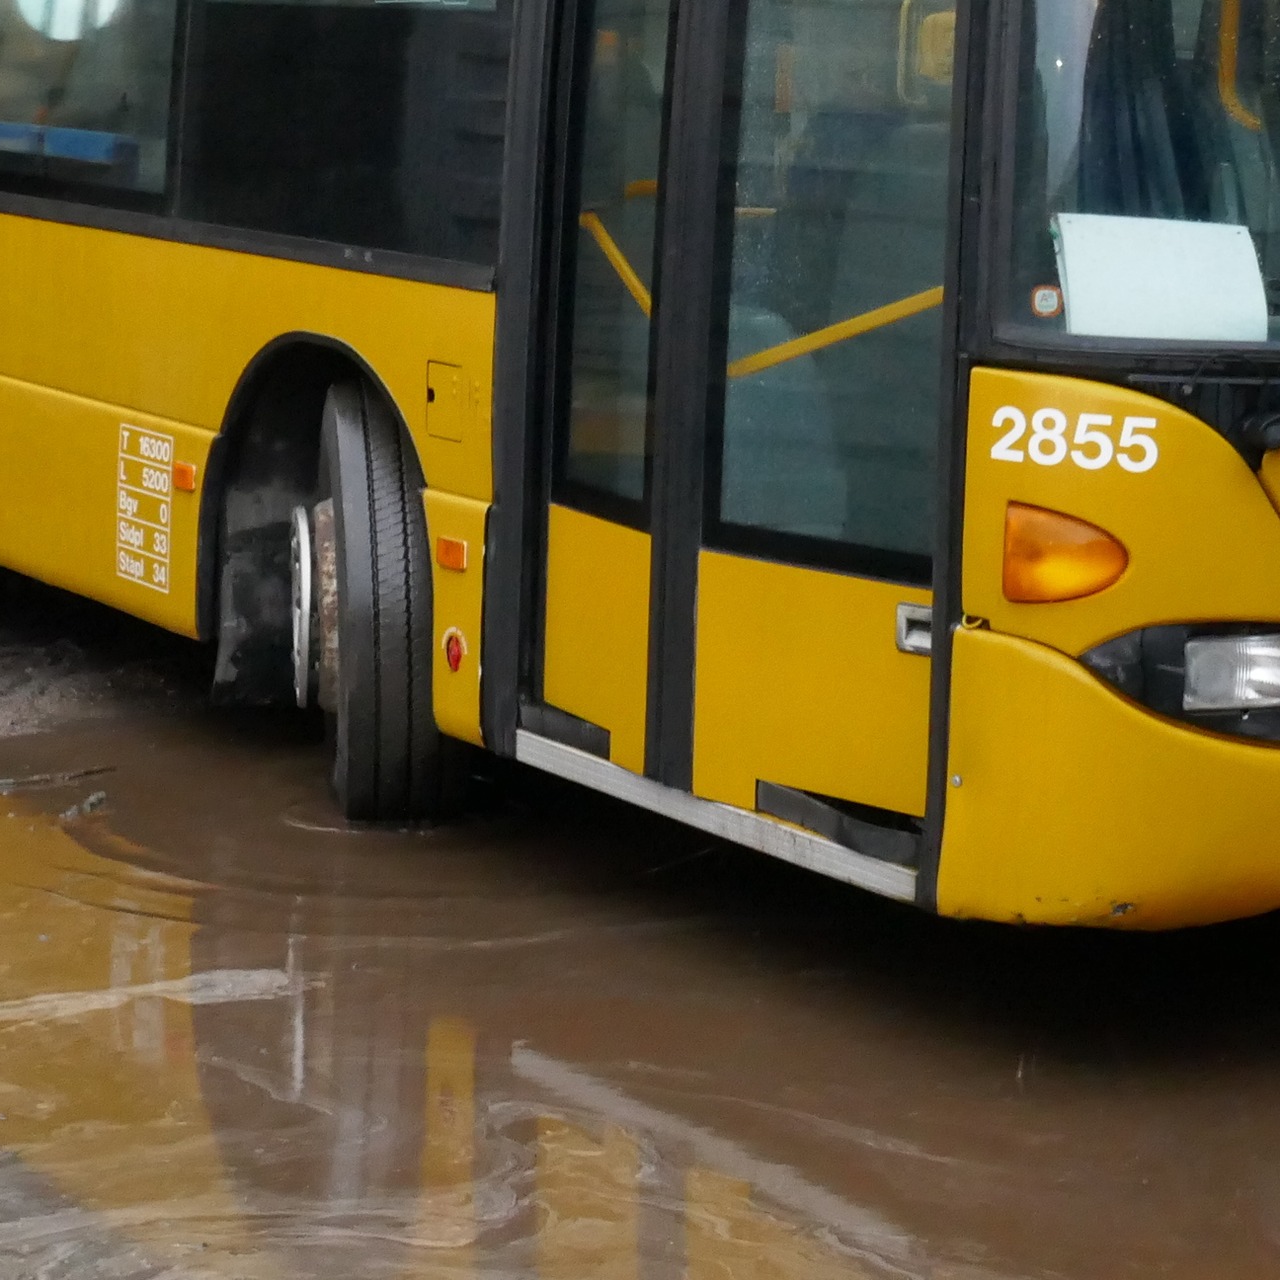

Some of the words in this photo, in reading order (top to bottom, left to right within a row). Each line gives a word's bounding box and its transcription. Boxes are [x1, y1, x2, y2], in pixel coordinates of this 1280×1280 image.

[122, 431, 130, 450] T
[139, 436, 170, 462] 16300
[991, 405, 1158, 473] 2855
[121, 461, 127, 480] L
[142, 467, 168, 493] 5200
[160, 503, 167, 524] 0
[153, 532, 167, 554] 33
[153, 563, 166, 584] 34
